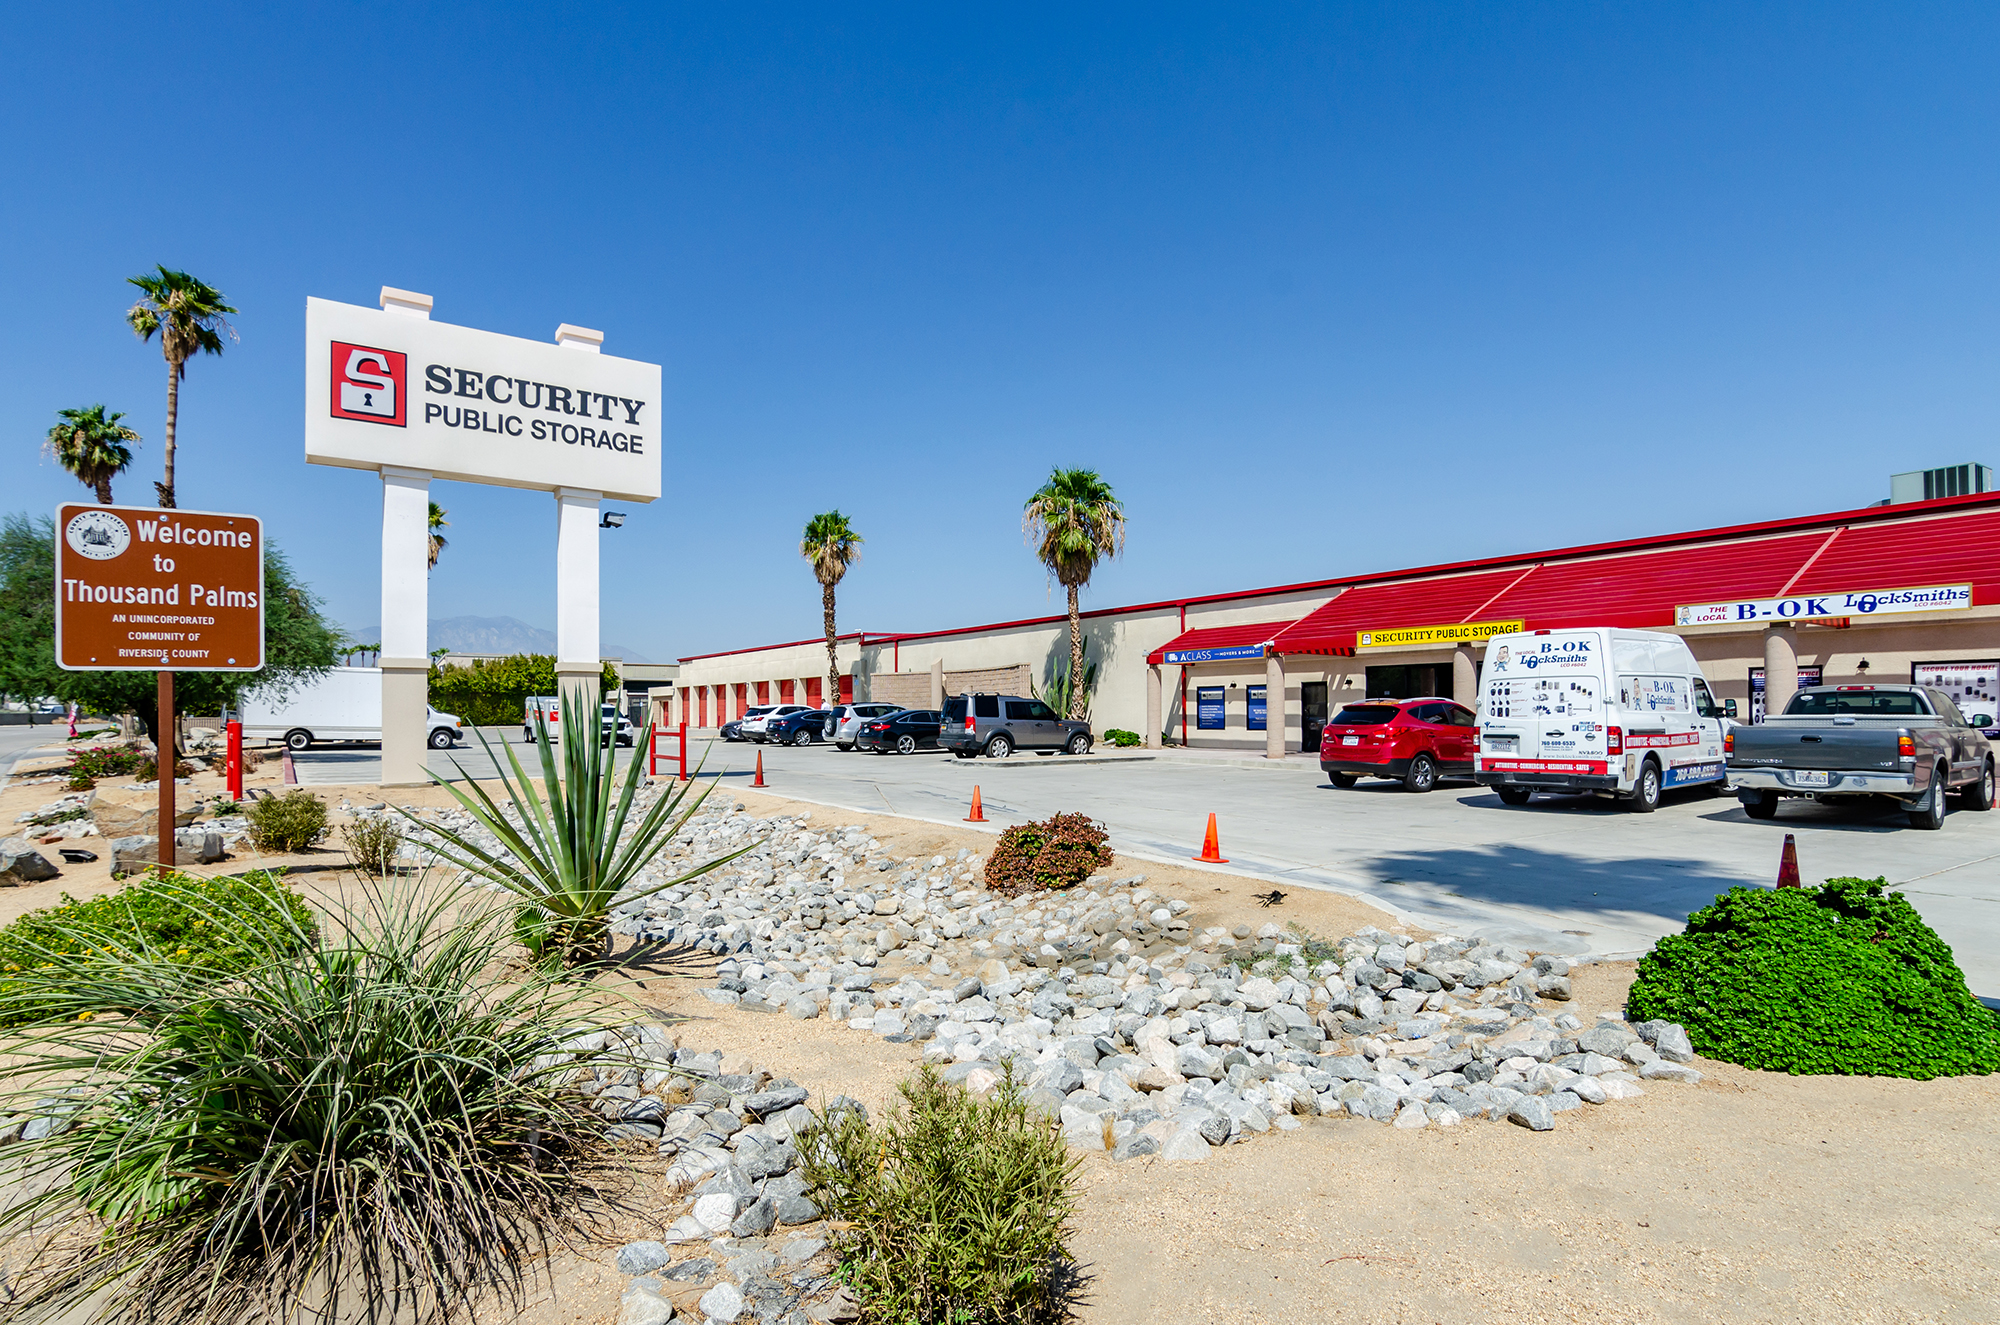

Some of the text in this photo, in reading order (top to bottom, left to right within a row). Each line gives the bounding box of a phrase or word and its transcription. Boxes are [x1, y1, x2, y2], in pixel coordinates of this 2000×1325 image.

[425, 363, 645, 426] SECURITY
[425, 403, 644, 455] PUBLIC STORAGE
[137, 519, 252, 549] Welcome
[153, 553, 175, 573] to
[64, 579, 258, 609] Thousand Palms
[1697, 614, 1728, 622] LOCAL
[1736, 597, 1832, 620] B-OK
[112, 614, 215, 625] AN UNINCORPORATED
[127, 631, 201, 641] COMMUNITY OF
[1375, 624, 1519, 643] SECURITY PUBLIC STORAGE
[118, 648, 210, 658] RIVERSIDE COUNTY
[1540, 641, 1592, 653] B-OK
